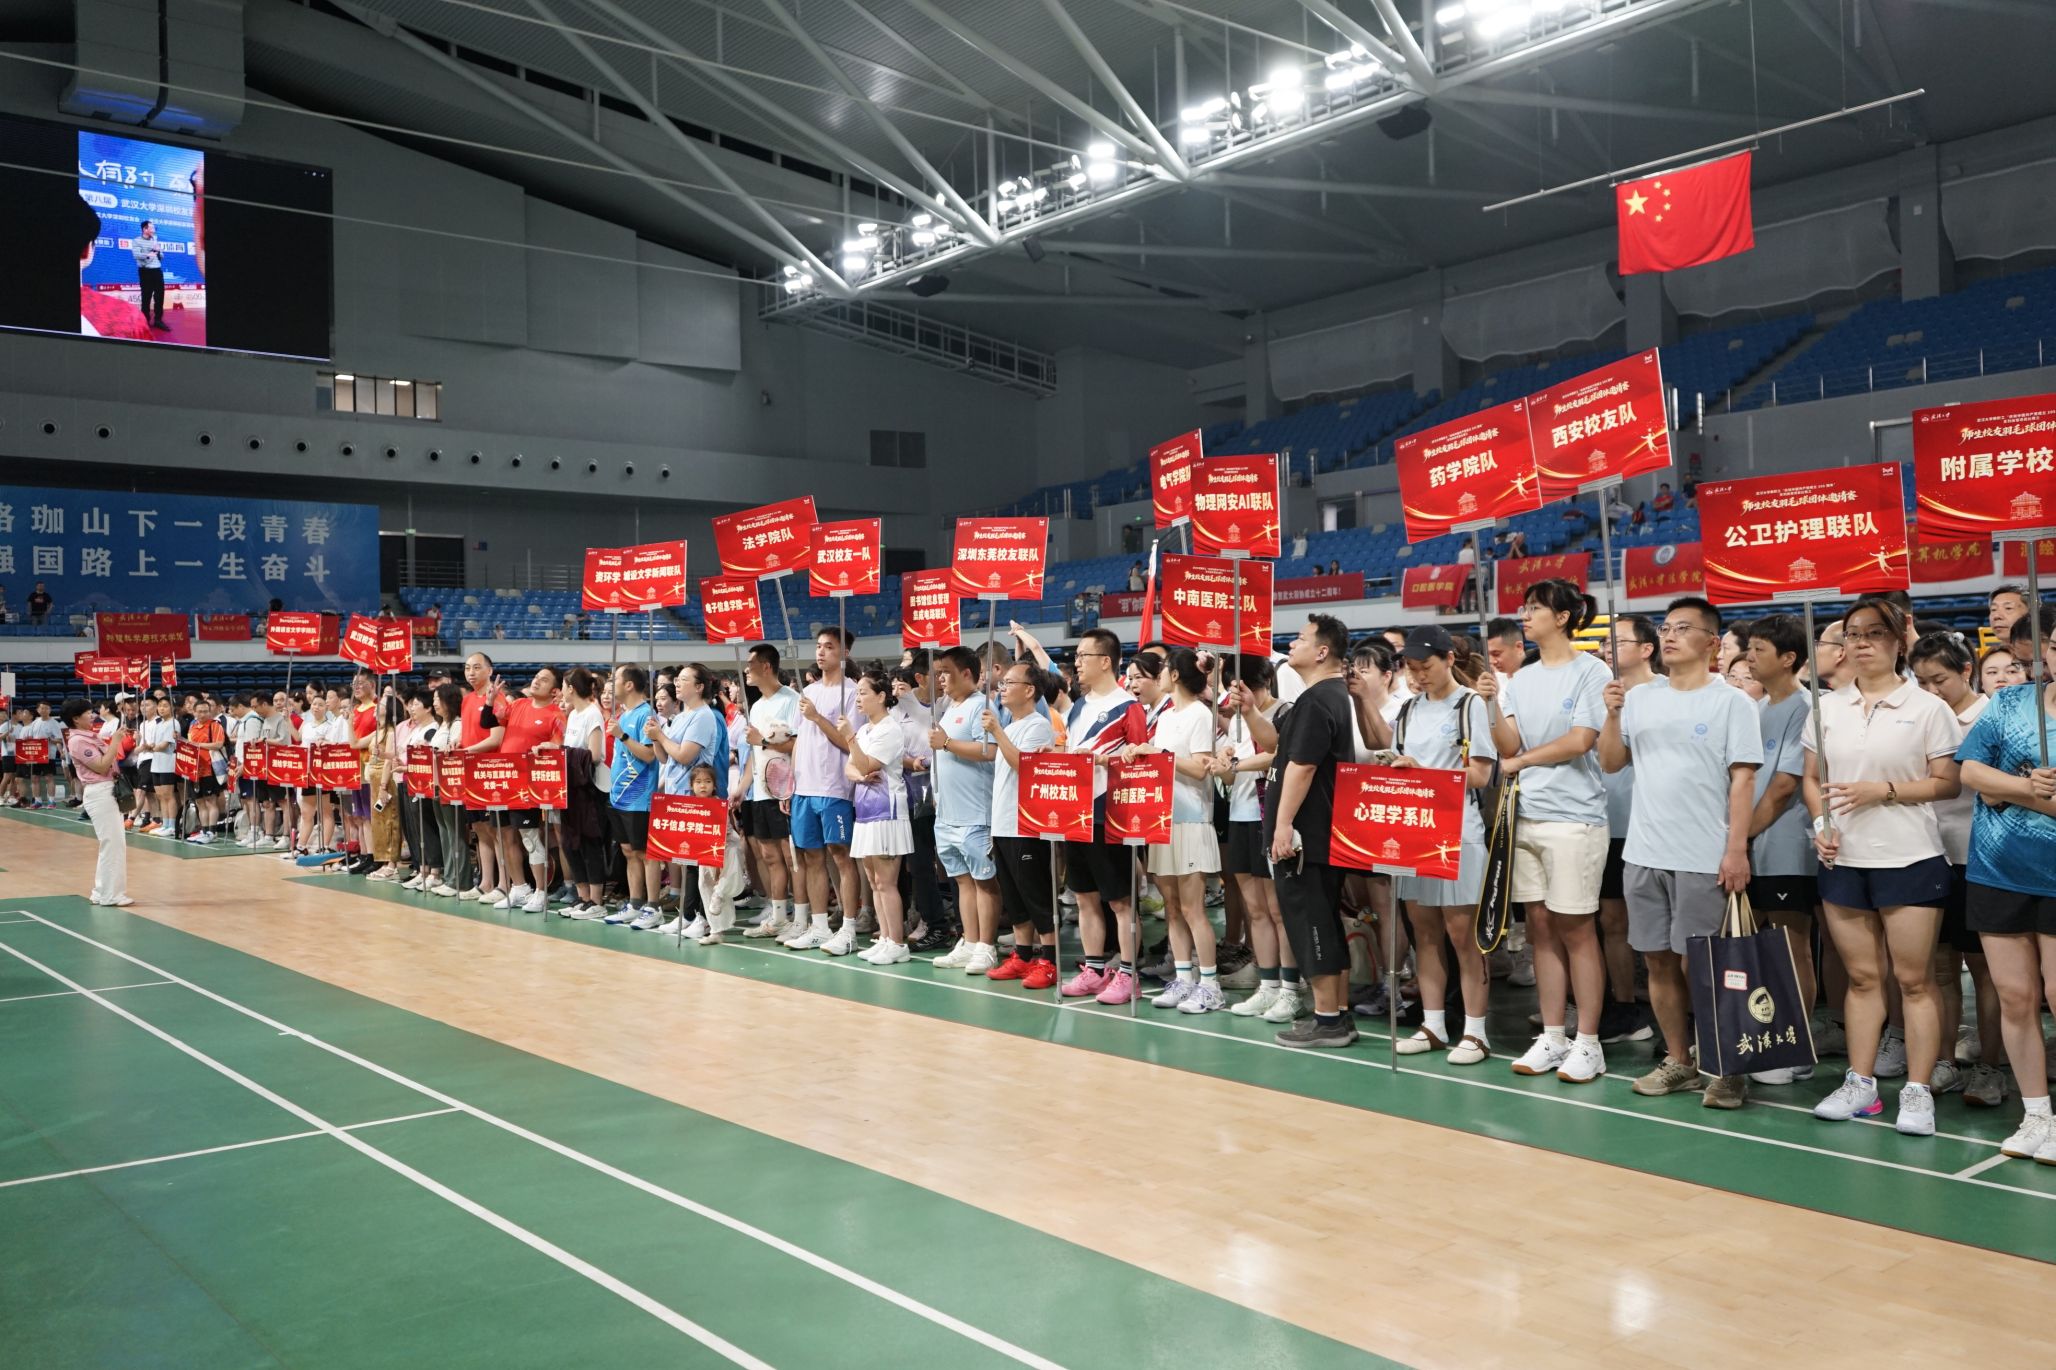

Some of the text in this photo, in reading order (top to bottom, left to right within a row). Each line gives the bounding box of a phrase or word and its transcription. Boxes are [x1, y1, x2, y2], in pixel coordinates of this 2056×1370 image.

[1552, 401, 1637, 448] 西安校友队
[1429, 450, 1498, 488] 药学院队
[1940, 447, 2054, 482] 附属学校
[1195, 492, 1274, 511] 物理网安AI联队
[742, 527, 794, 550] 法学院队
[1724, 512, 1879, 548] 公卫护理联队
[817, 546, 871, 563] 武汉校友一队
[957, 548, 1039, 562] 深圳东莞校友联队
[1907, 542, 1981, 564] 算机学院
[705, 598, 756, 614] 电子信息学院一队
[1173, 588, 1257, 612] 中南医院二队
[1030, 783, 1078, 802] 广州校友队
[1113, 786, 1164, 804] 中南医院一队
[1354, 802, 1436, 829] 心理学系队
[653, 818, 721, 836] 电子信息学院二队
